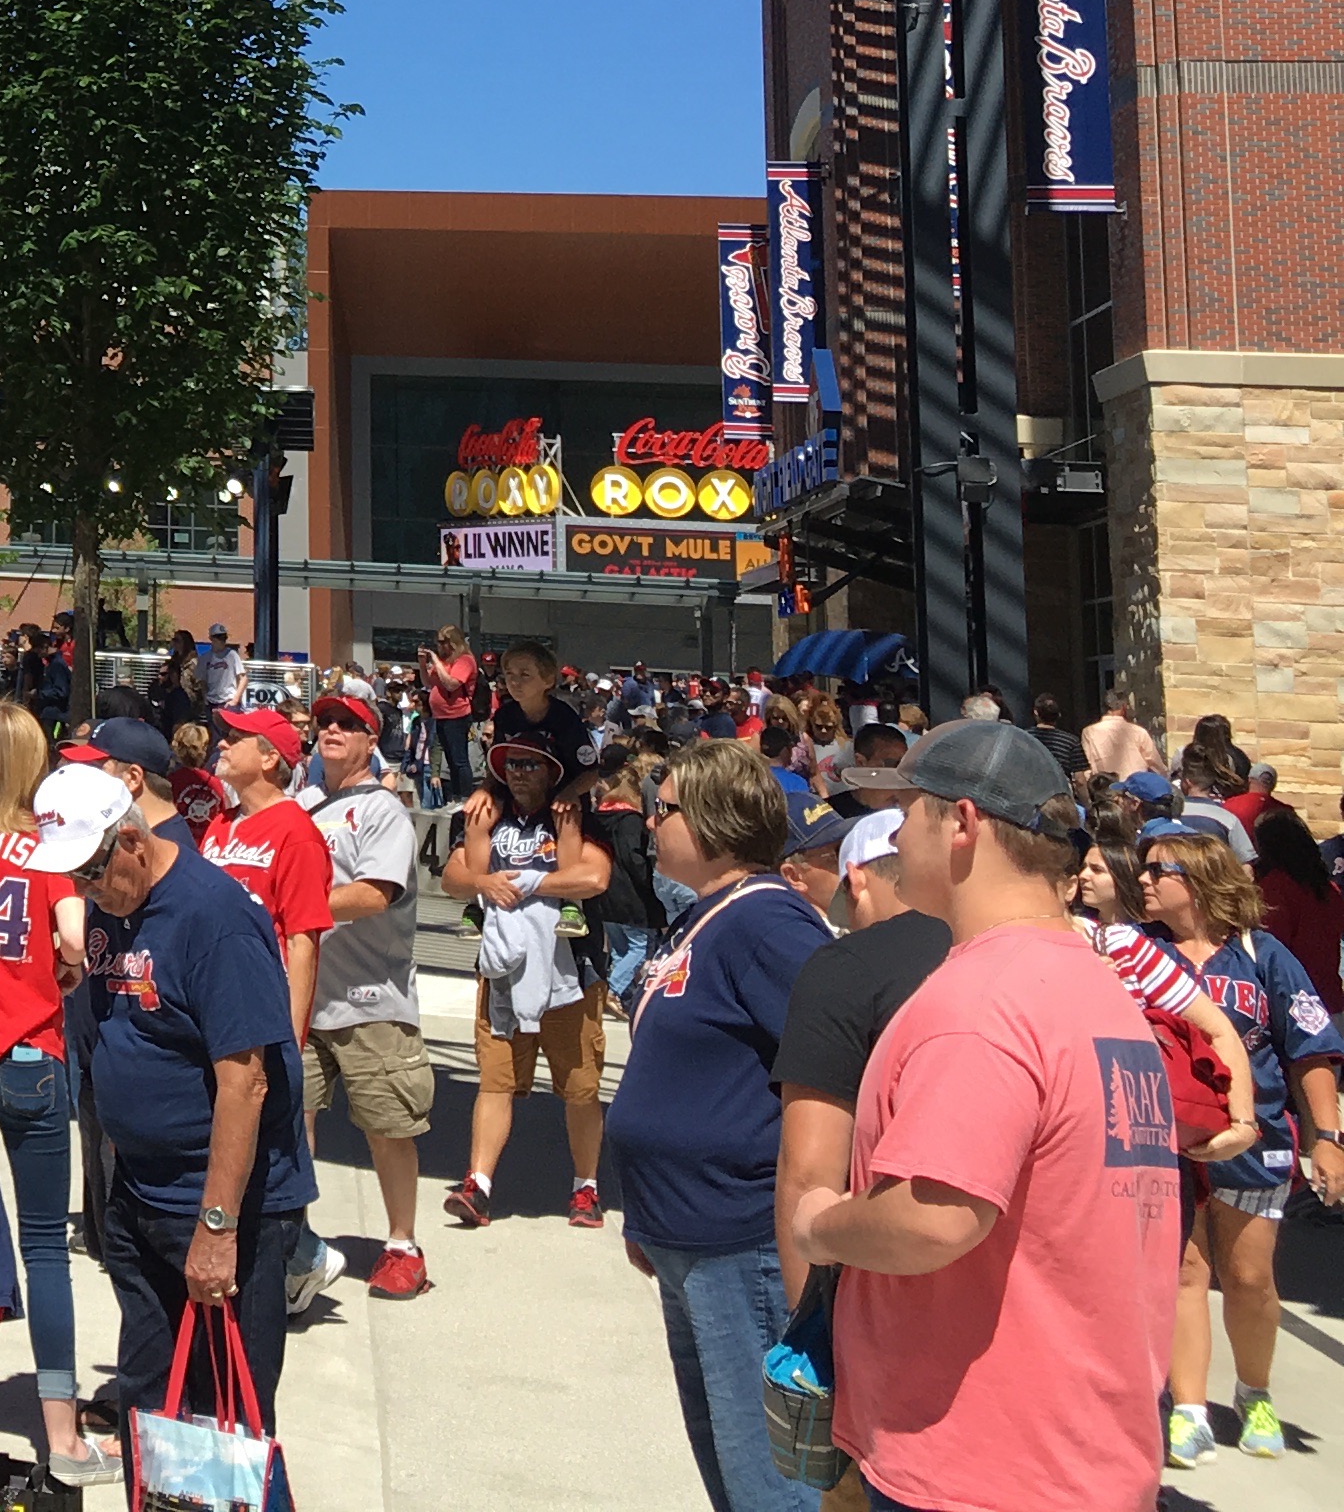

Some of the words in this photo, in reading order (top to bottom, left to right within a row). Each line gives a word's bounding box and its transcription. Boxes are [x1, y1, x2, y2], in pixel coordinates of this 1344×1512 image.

[1035, 34, 1097, 184] Braves
[779, 178, 812, 295] Atlanta
[722, 265, 771, 386] Braves
[778, 286, 818, 384] Braves
[452, 473, 548, 510] ROXY
[603, 473, 737, 513] ROX
[464, 531, 486, 560] LIL
[486, 529, 550, 559] WAYNE
[571, 533, 654, 557] GOV'T
[665, 537, 732, 561] MULE
[246, 689, 279, 705] FOX
